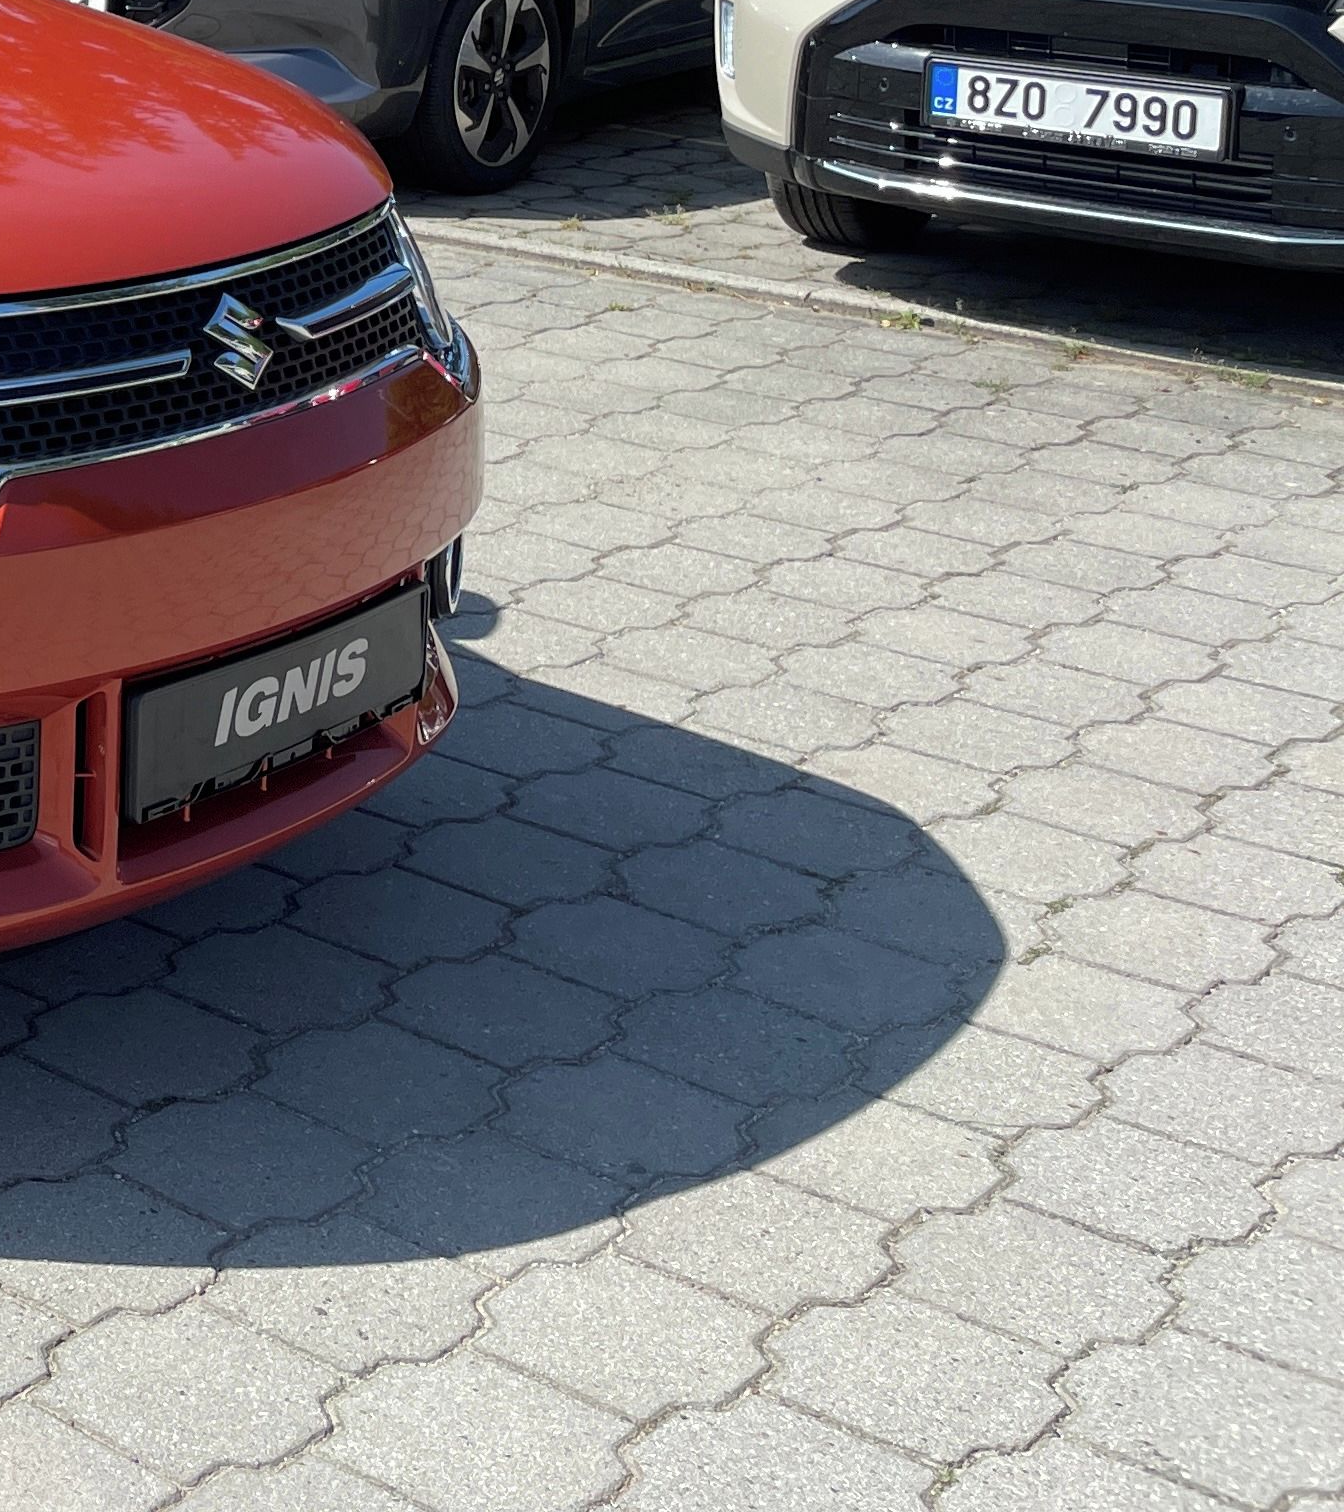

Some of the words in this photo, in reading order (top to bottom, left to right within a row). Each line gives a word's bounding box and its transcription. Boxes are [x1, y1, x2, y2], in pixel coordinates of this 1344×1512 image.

[933, 96, 953, 110] CZ
[1083, 88, 1199, 140] 7990
[214, 638, 369, 747] IGNIS
